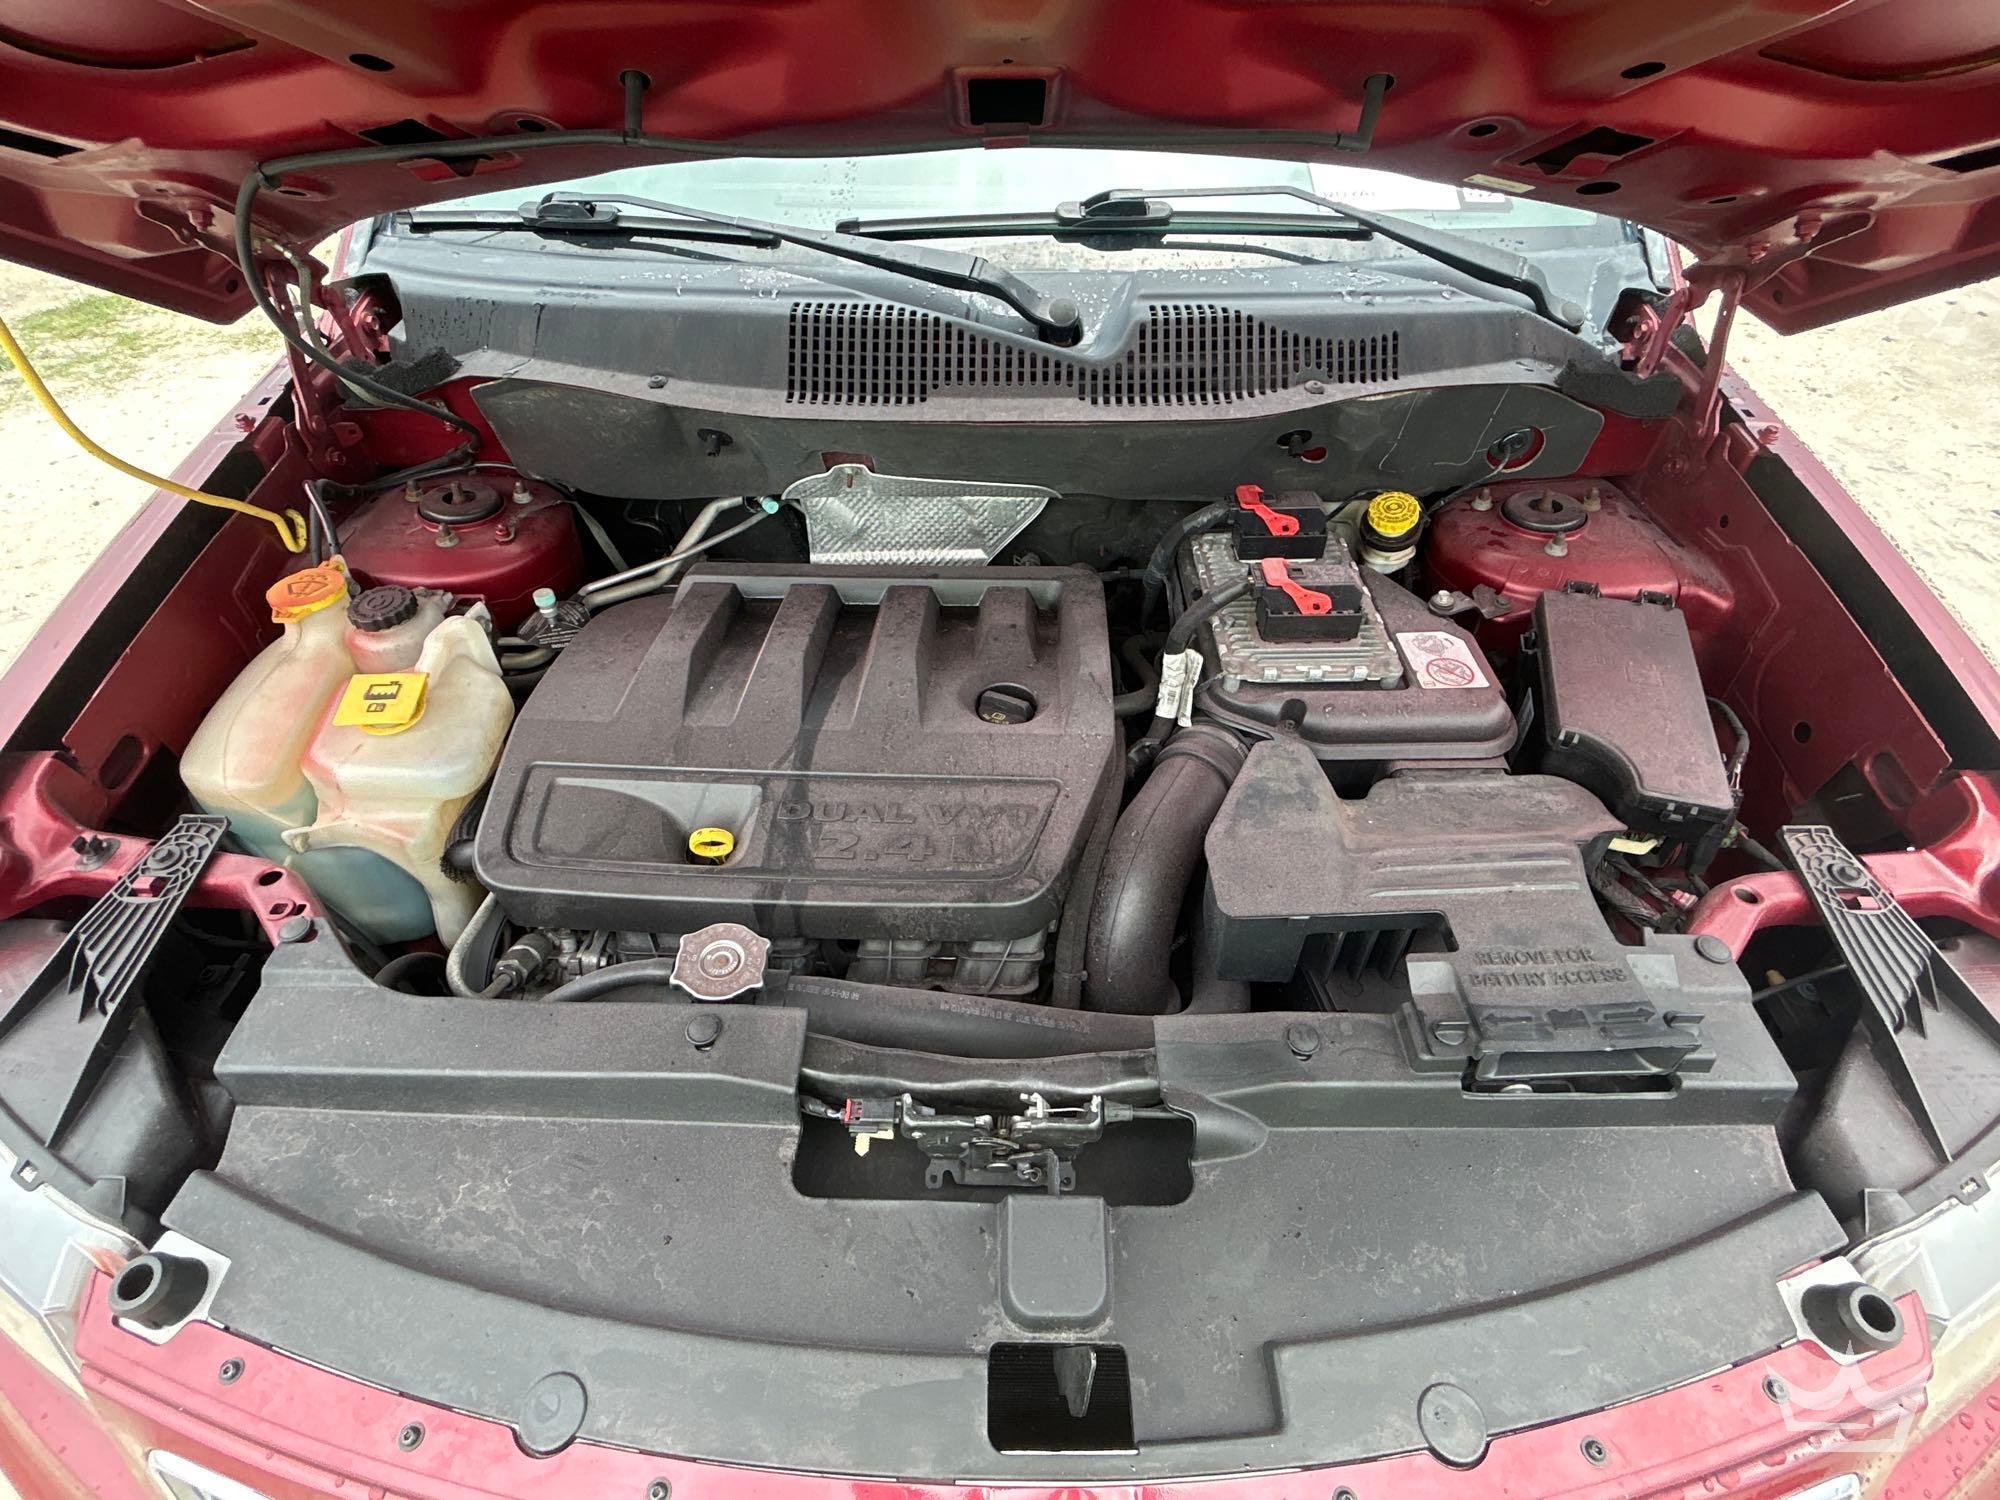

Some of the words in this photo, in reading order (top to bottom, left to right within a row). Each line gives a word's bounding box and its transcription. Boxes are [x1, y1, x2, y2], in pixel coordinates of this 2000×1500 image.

[776, 802, 918, 824] DUAL
[814, 832, 936, 862] 2.4
[1474, 950, 1553, 966] REMOVE
[1554, 948, 1599, 963] FOR
[1470, 971, 1547, 987] BATTERY
[1553, 967, 1630, 986] ACCESS
